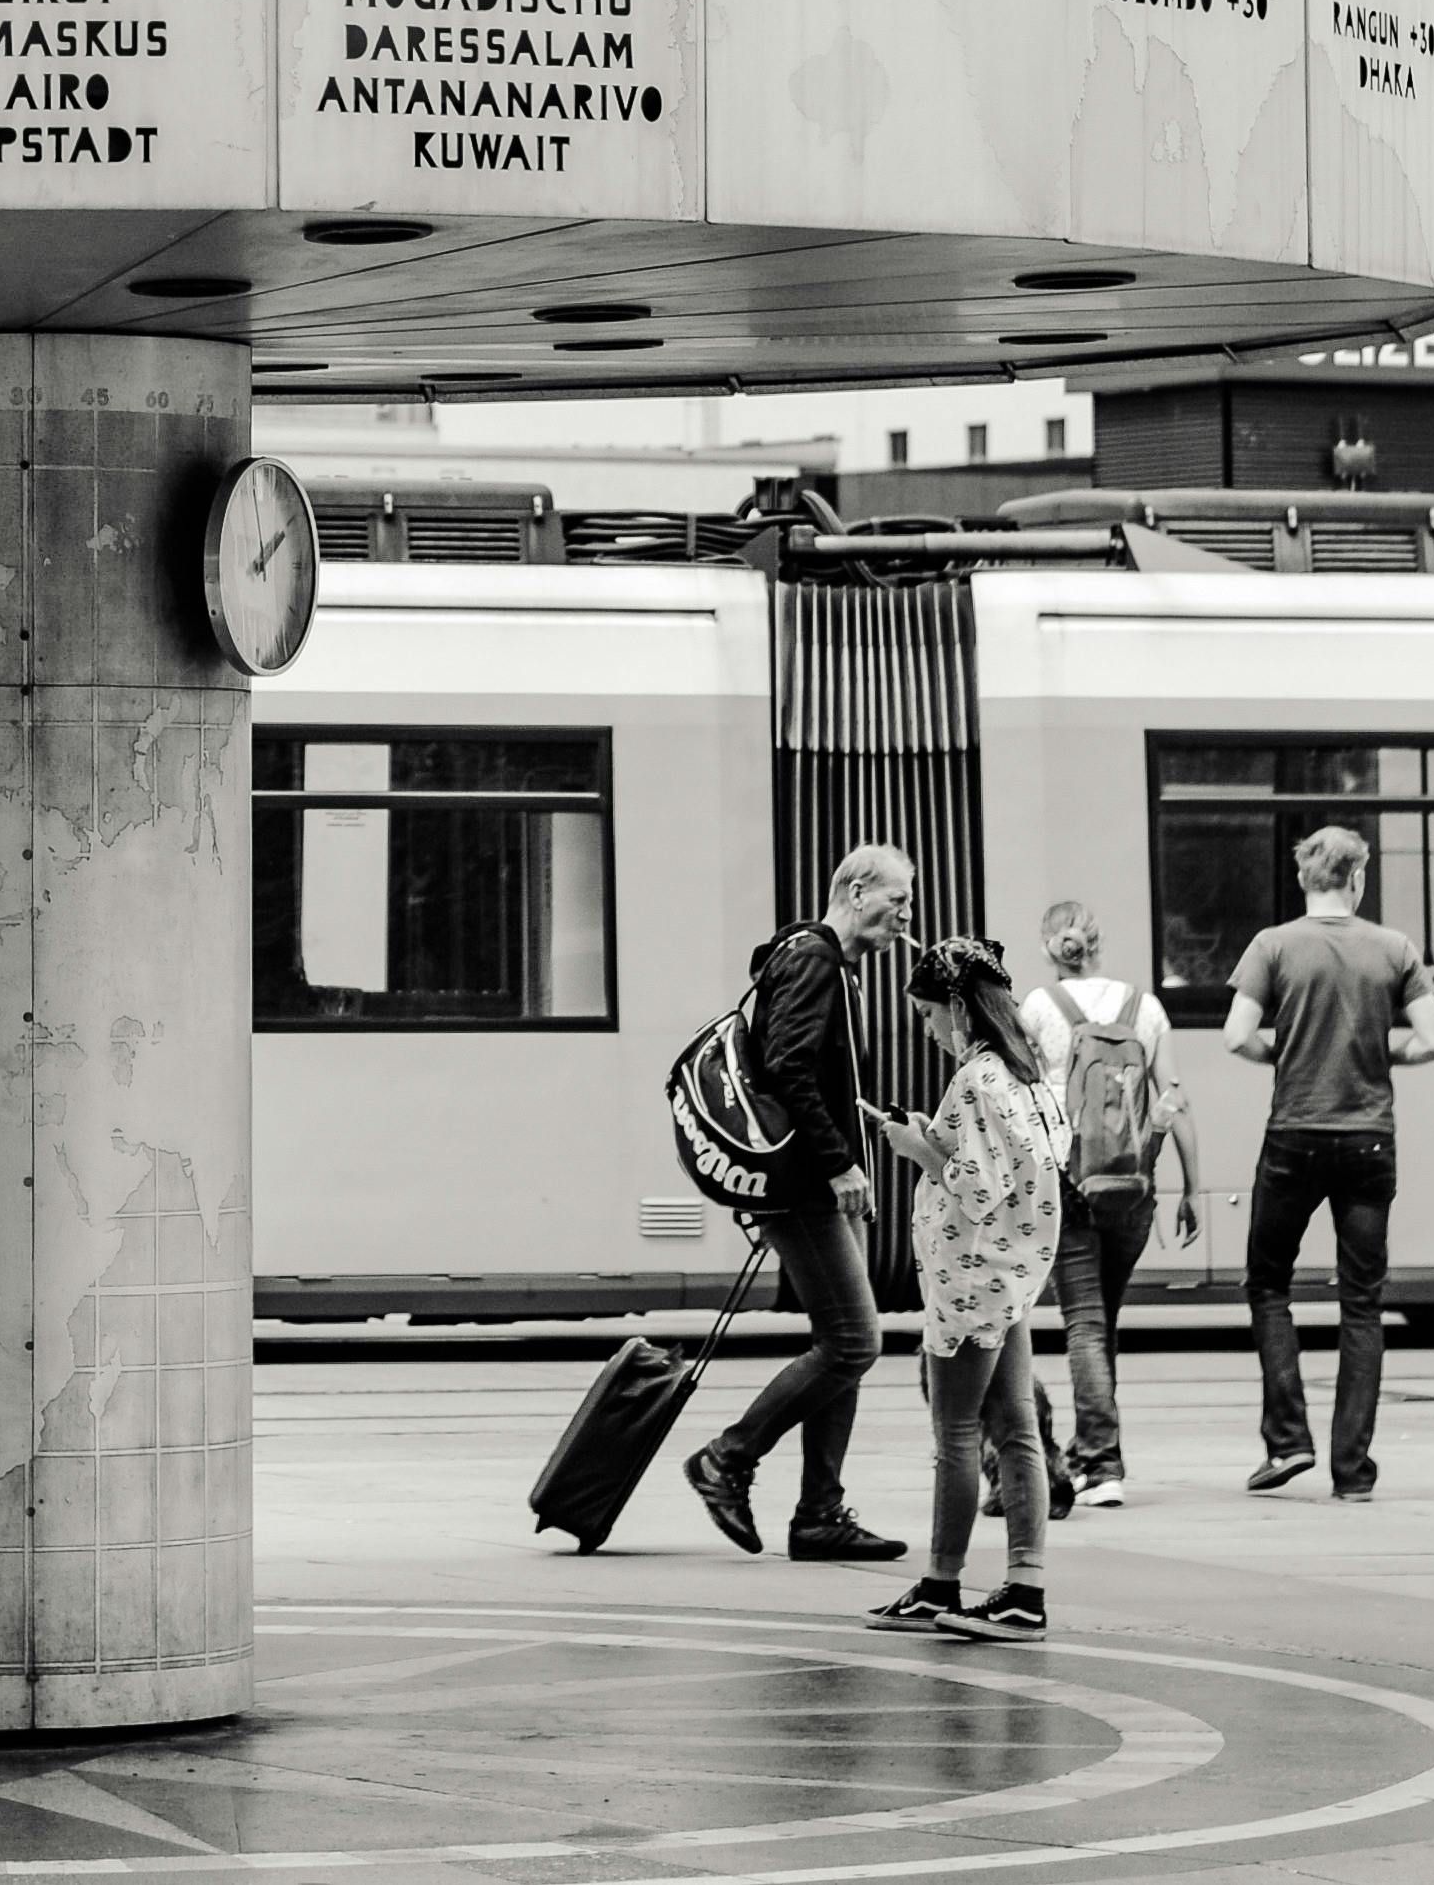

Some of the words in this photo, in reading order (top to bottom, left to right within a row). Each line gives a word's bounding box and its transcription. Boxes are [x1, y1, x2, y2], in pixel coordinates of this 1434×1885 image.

[345, 24, 634, 69] DARESSALAM
[1333, 1, 1399, 49] RANGUN
[316, 76, 663, 123] ANTANANARIVO
[1359, 55, 1416, 100] DHAKA
[413, 131, 571, 172] KUWAIT
[81, 388, 109, 406] 45
[146, 391, 170, 408] 60
